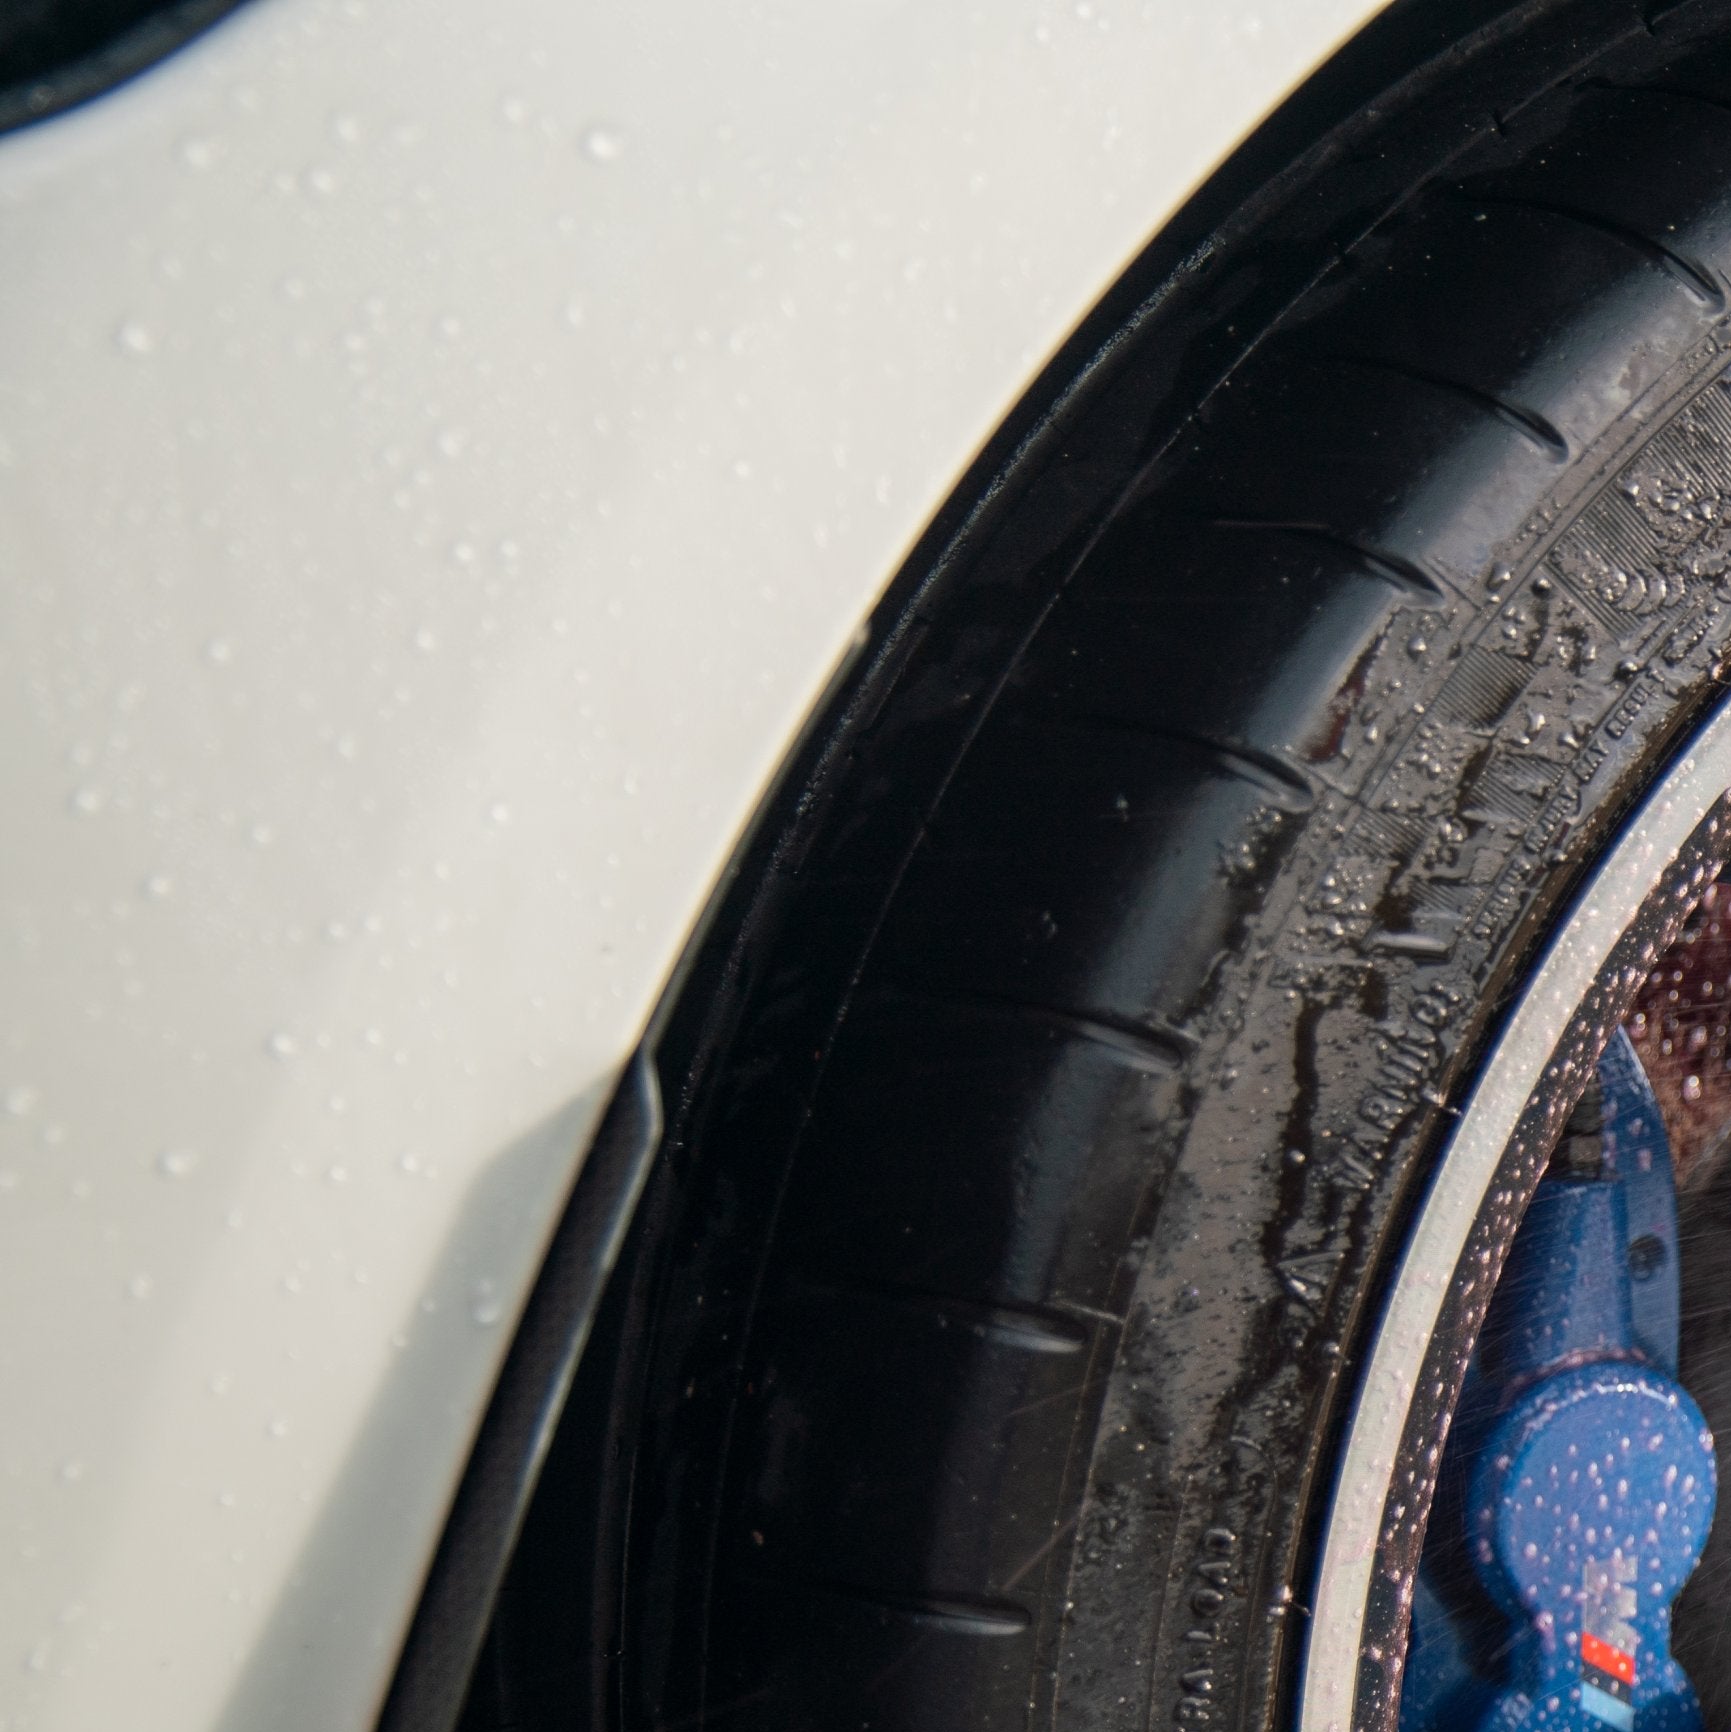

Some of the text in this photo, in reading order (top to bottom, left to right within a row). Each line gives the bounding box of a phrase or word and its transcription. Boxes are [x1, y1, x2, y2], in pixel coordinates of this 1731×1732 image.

[1571, 736, 1613, 785] MAY
[1601, 663, 1666, 743] RESULT
[1184, 1522, 1240, 1646] LOAD
